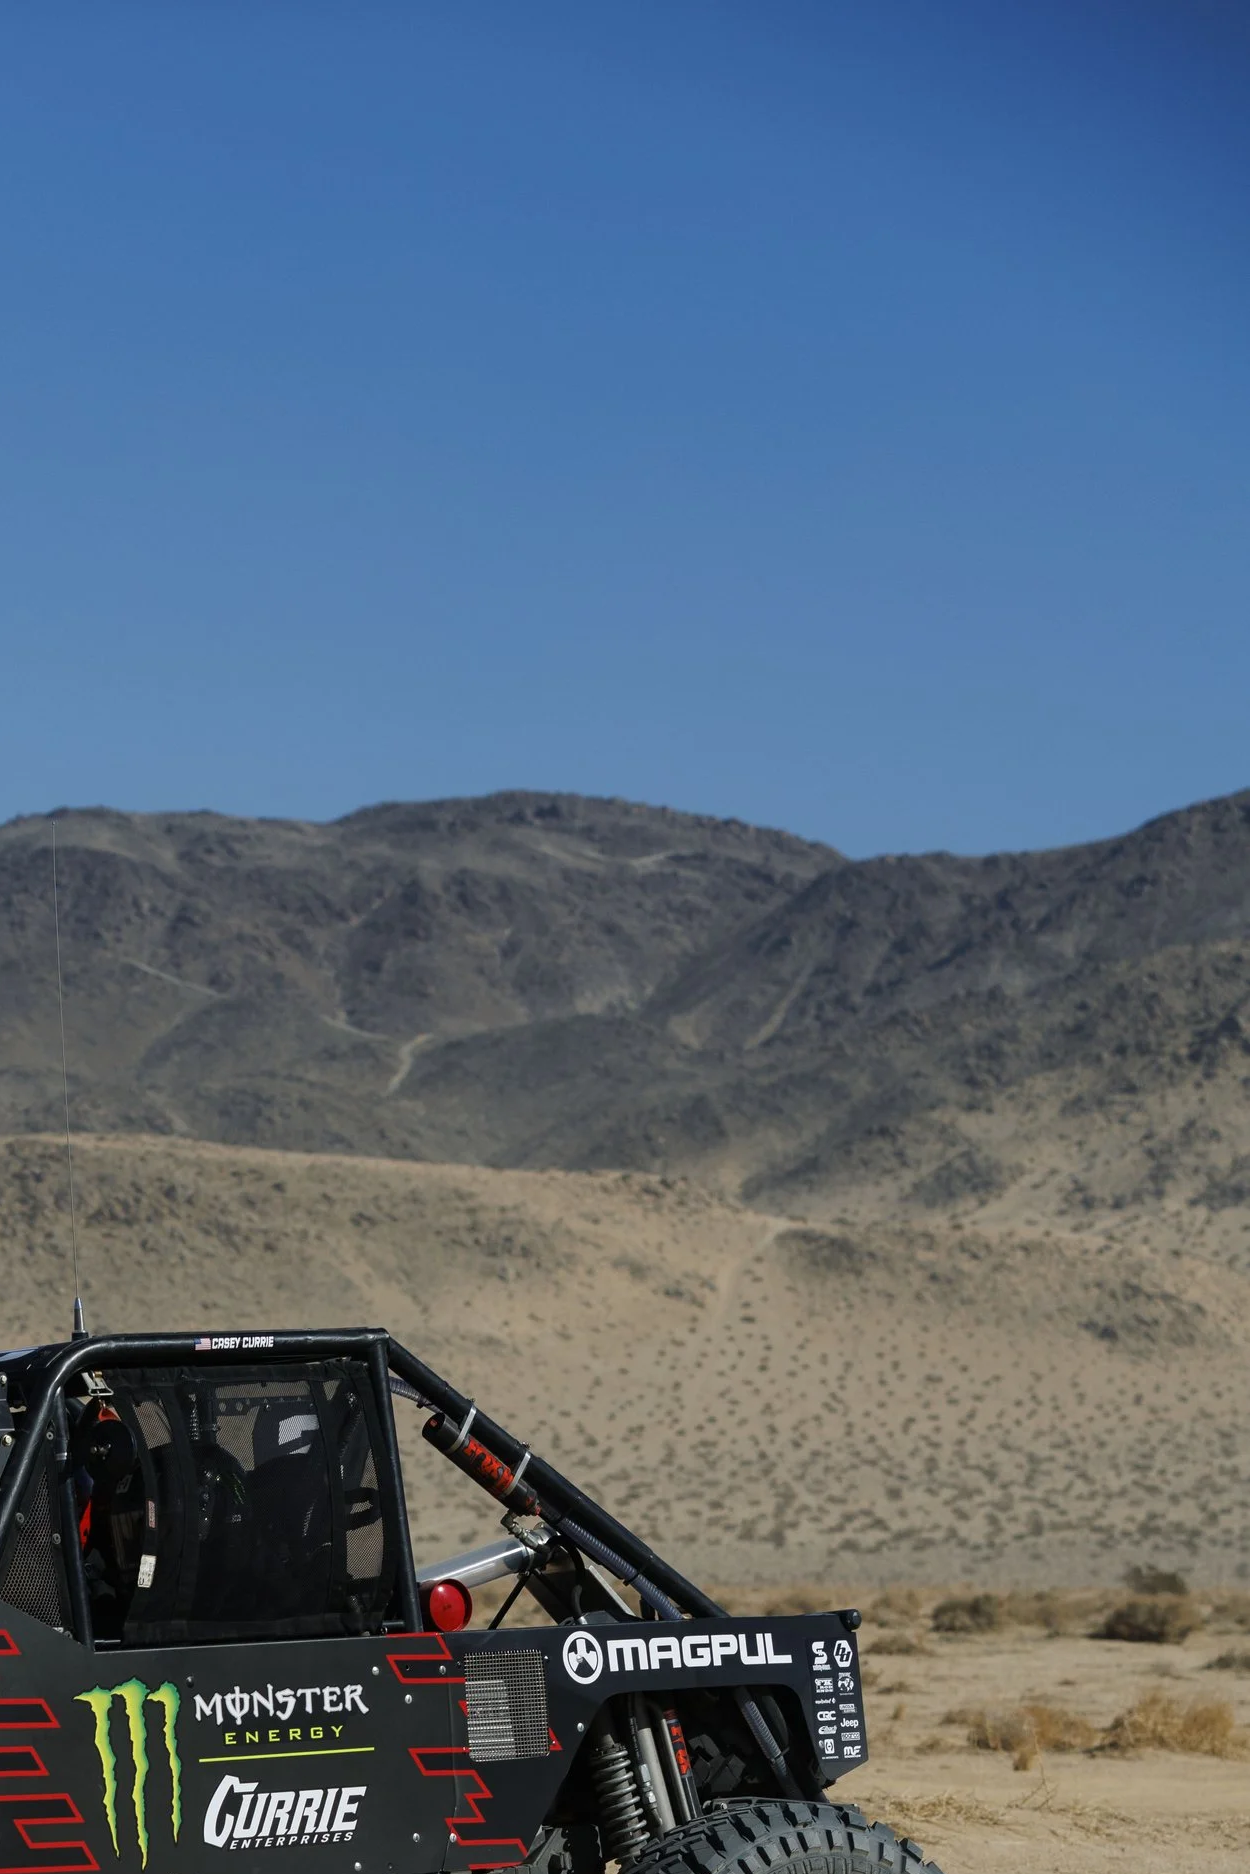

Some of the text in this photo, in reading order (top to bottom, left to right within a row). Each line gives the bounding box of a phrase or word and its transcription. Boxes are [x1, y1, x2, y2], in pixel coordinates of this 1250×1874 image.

[212, 1336, 274, 1350] CASEY CURRIE
[606, 1632, 793, 1672] MAGPUL
[193, 1683, 370, 1726] MONSTER
[840, 1718, 859, 1729] Jeep
[225, 1725, 344, 1745] ENERGY
[204, 1774, 368, 1849] CURRIE
[229, 1831, 354, 1850] ENTERPRISES
